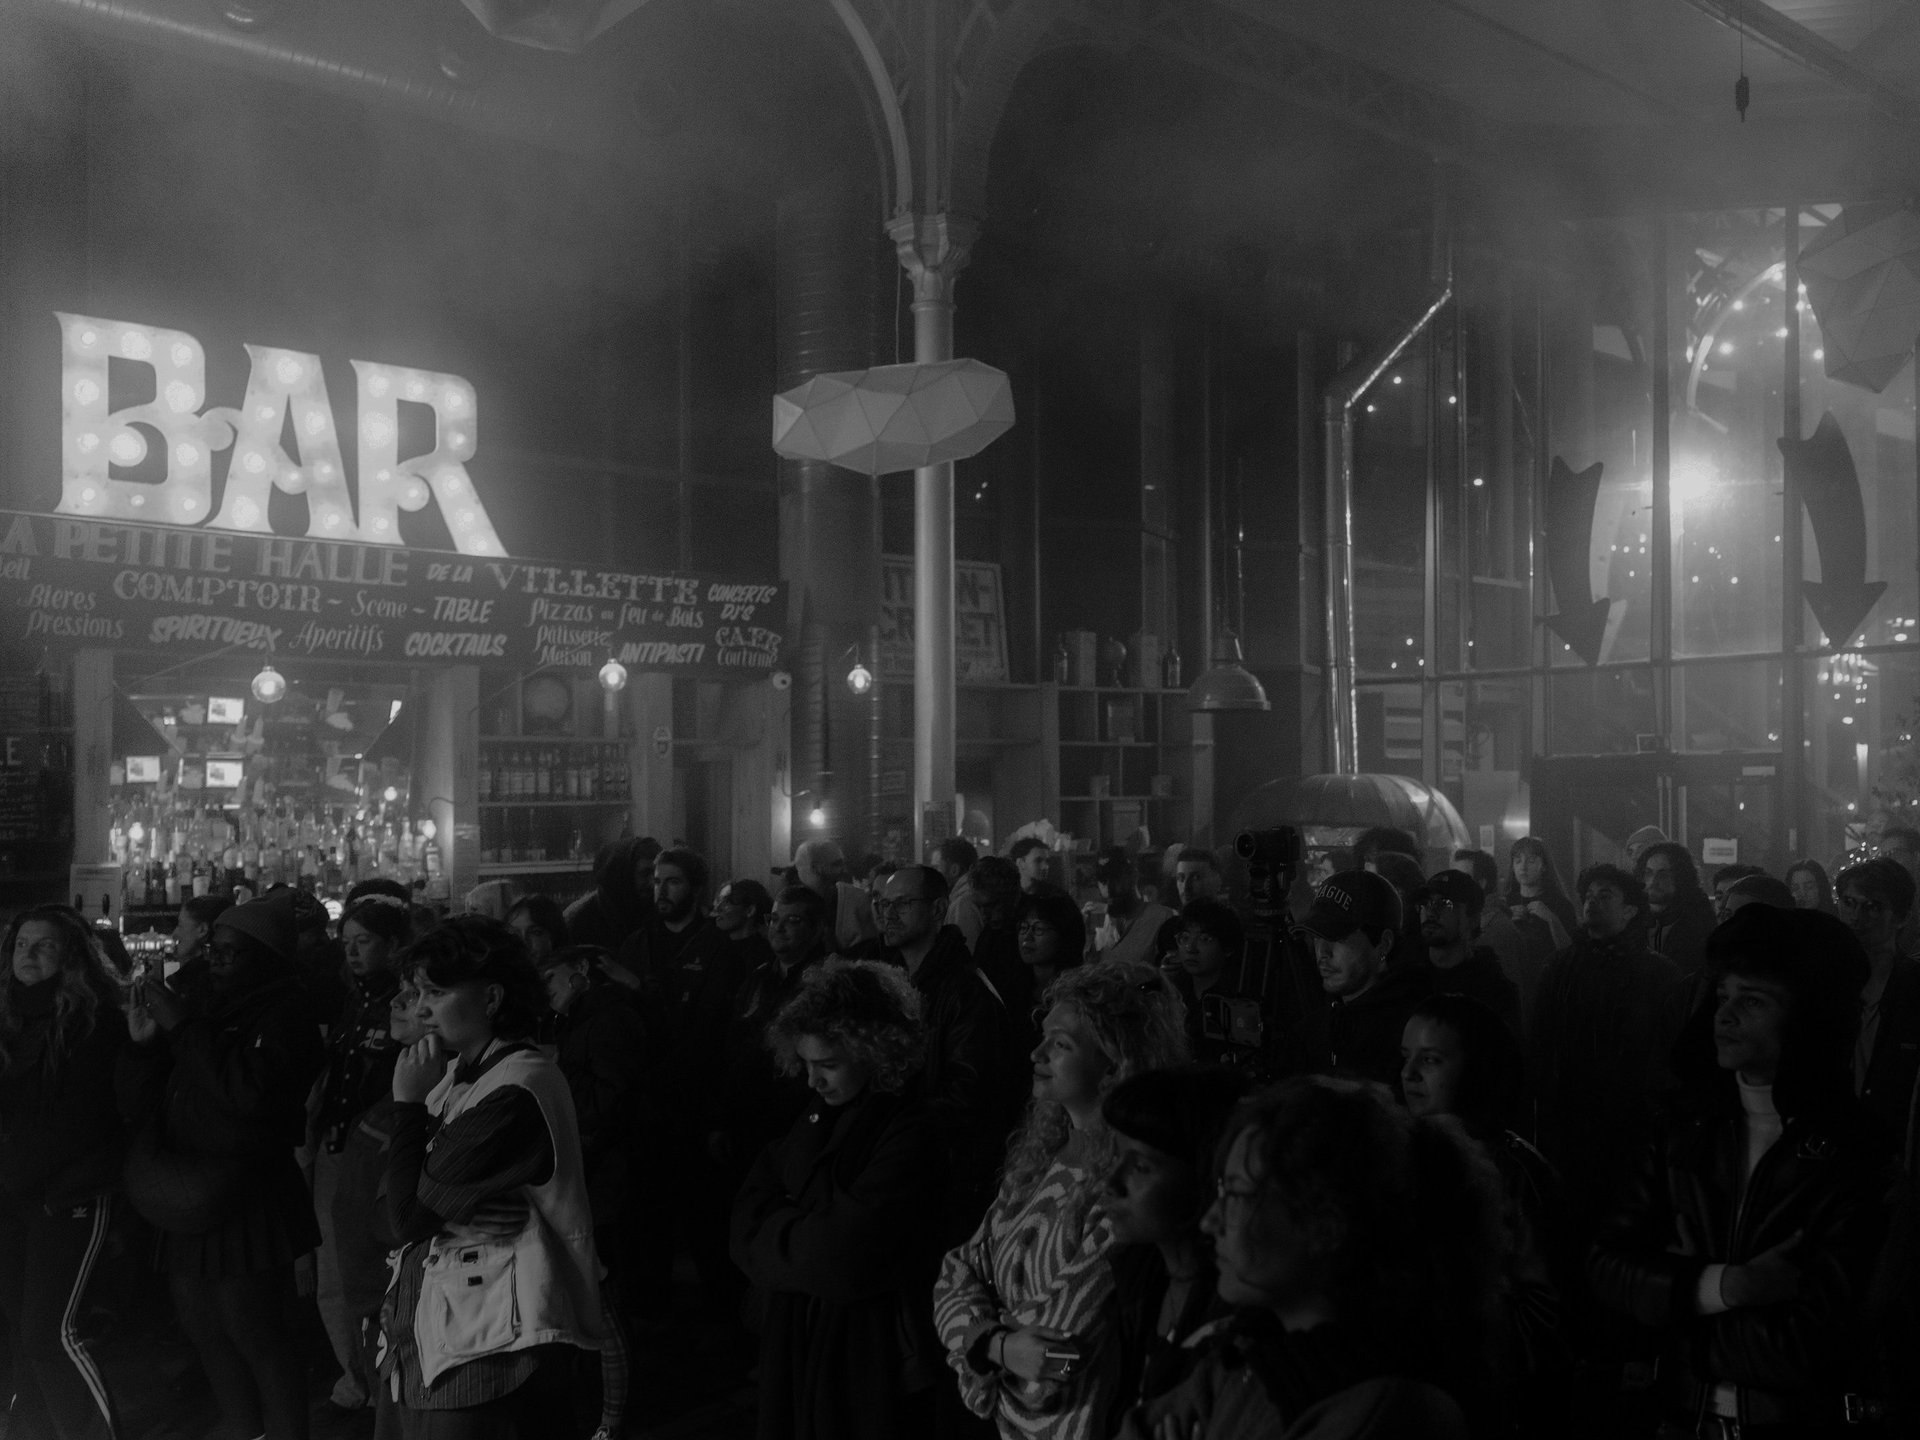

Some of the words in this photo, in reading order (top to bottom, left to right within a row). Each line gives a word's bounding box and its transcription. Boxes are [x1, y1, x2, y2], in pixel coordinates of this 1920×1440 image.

[53, 311, 510, 558] BAR
[0, 556, 31, 582] ell
[53, 519, 234, 572] PETITE
[256, 540, 410, 586] HALLE
[426, 563, 451, 581] DE
[452, 564, 474, 583] LA
[485, 562, 700, 605] VILLETTE
[112, 570, 321, 613] COMPTOIR
[433, 596, 495, 624] TABLE
[708, 583, 778, 604] CONCERTS
[25, 609, 124, 639] Pressions
[526, 597, 594, 627] Pizzas
[618, 602, 648, 630] feu
[666, 605, 704, 629] Bois
[405, 631, 508, 657] COCKTAILS
[618, 642, 706, 664] ANTIPASTI
[1317, 884, 1353, 911] AGUE
